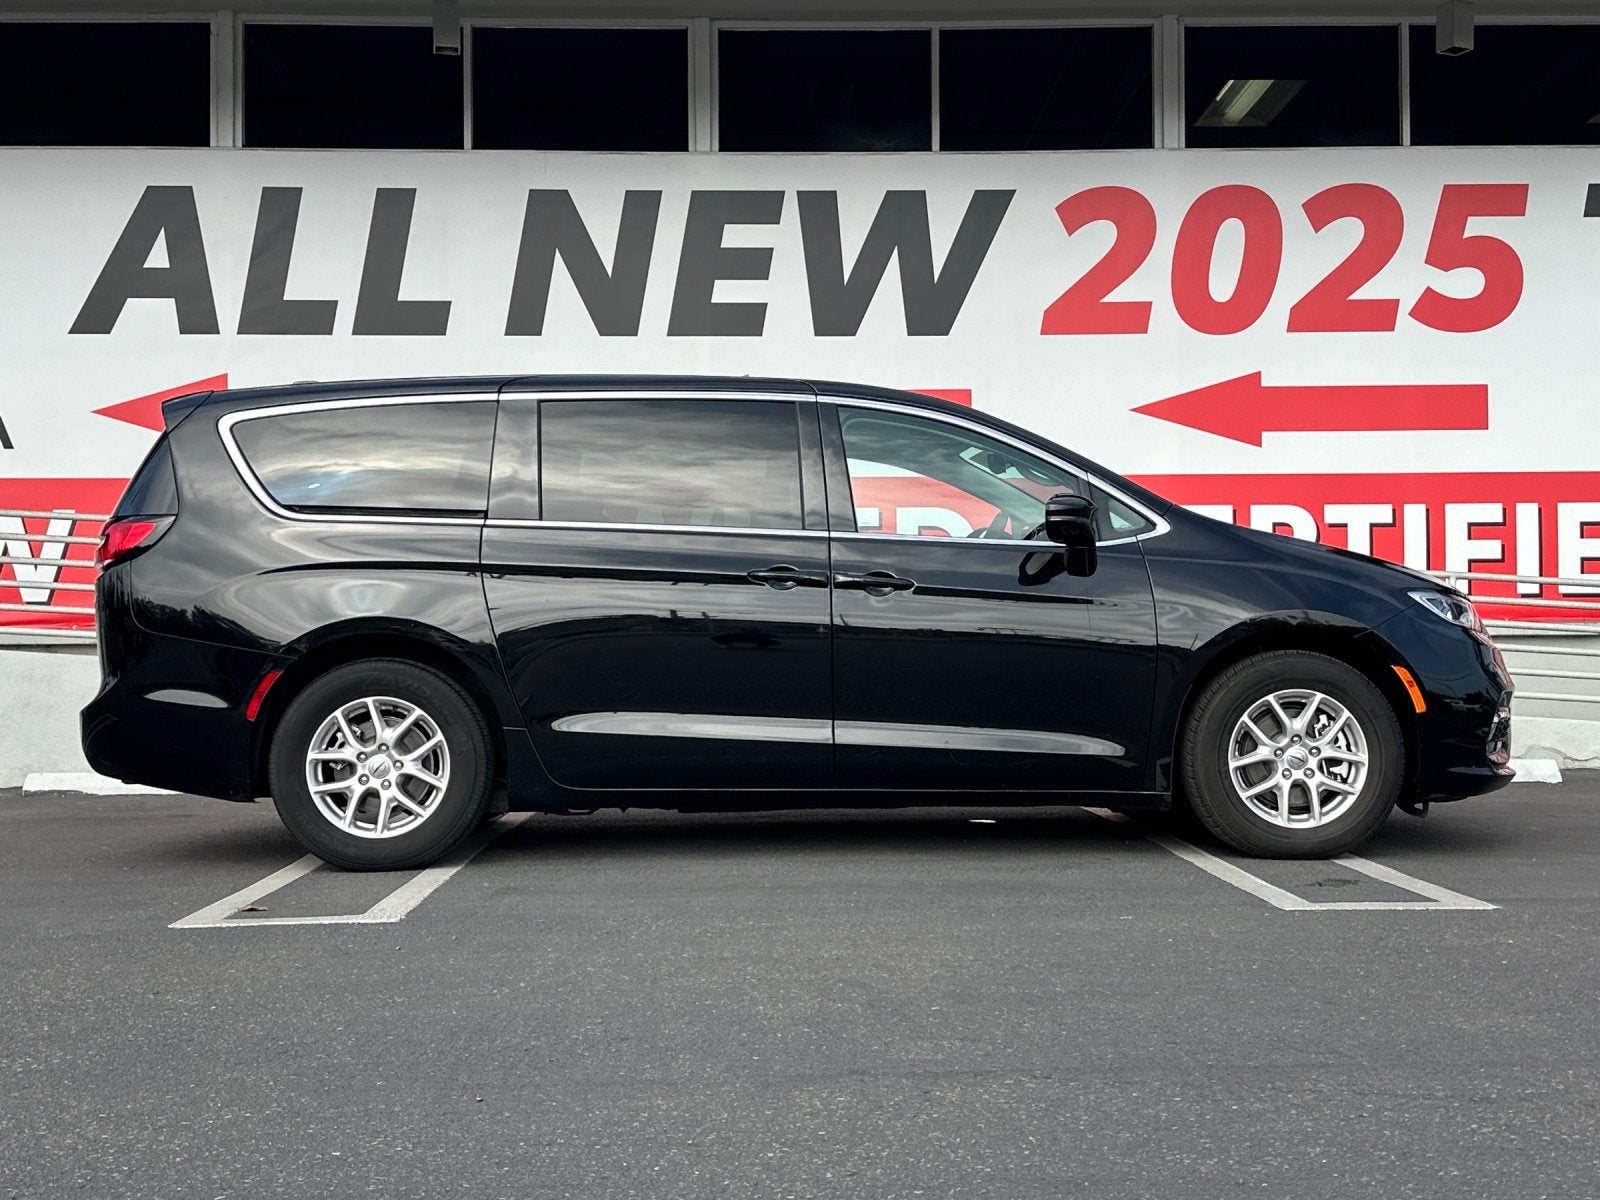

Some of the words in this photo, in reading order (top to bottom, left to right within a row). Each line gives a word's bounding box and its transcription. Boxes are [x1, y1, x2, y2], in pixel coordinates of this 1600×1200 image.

[68, 186, 451, 335] ALL
[505, 189, 1016, 337] NEW
[1041, 183, 1529, 335] 2025
